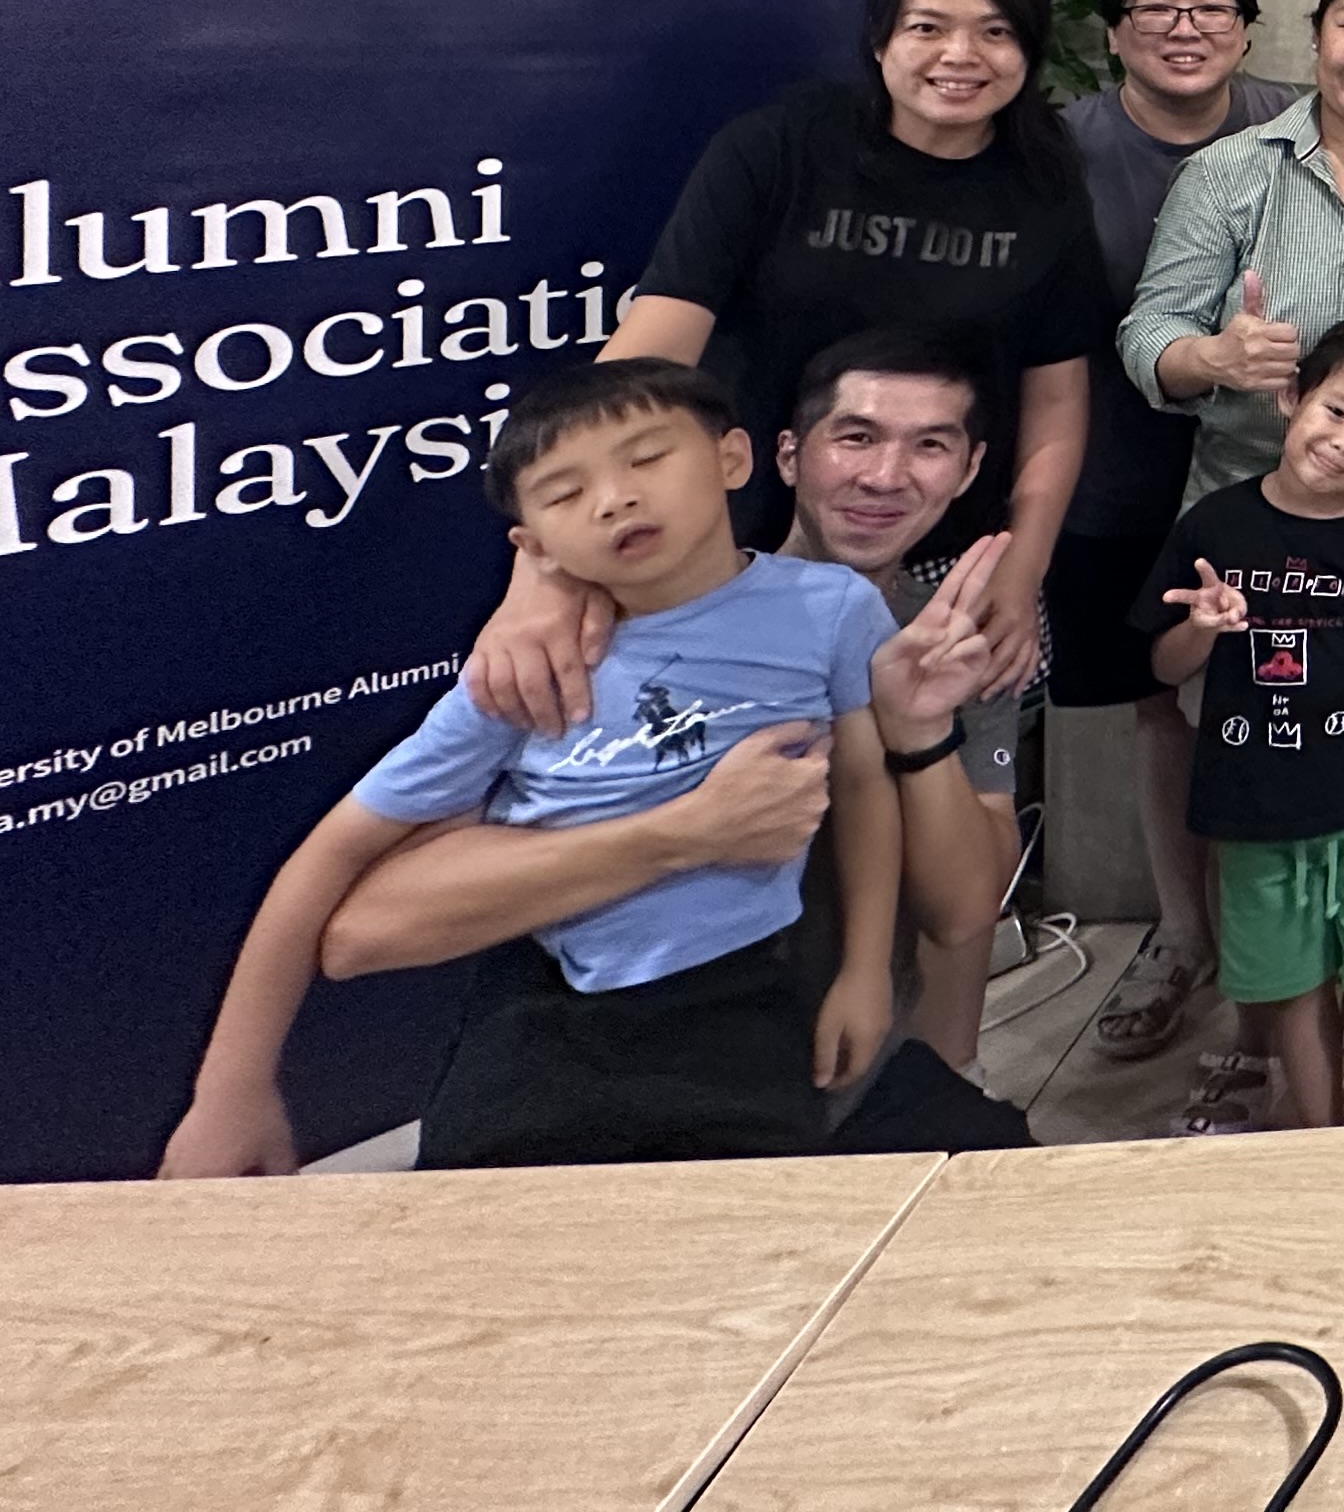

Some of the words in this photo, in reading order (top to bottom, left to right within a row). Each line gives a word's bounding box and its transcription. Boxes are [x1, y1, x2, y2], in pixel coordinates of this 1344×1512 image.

[9, 157, 512, 287] lumni
[807, 207, 918, 258] JUST
[919, 220, 974, 267] DO
[3, 260, 638, 422] ssociati
[109, 727, 151, 760] of
[156, 685, 343, 748] Melbourne
[347, 652, 460, 700] Alumni
